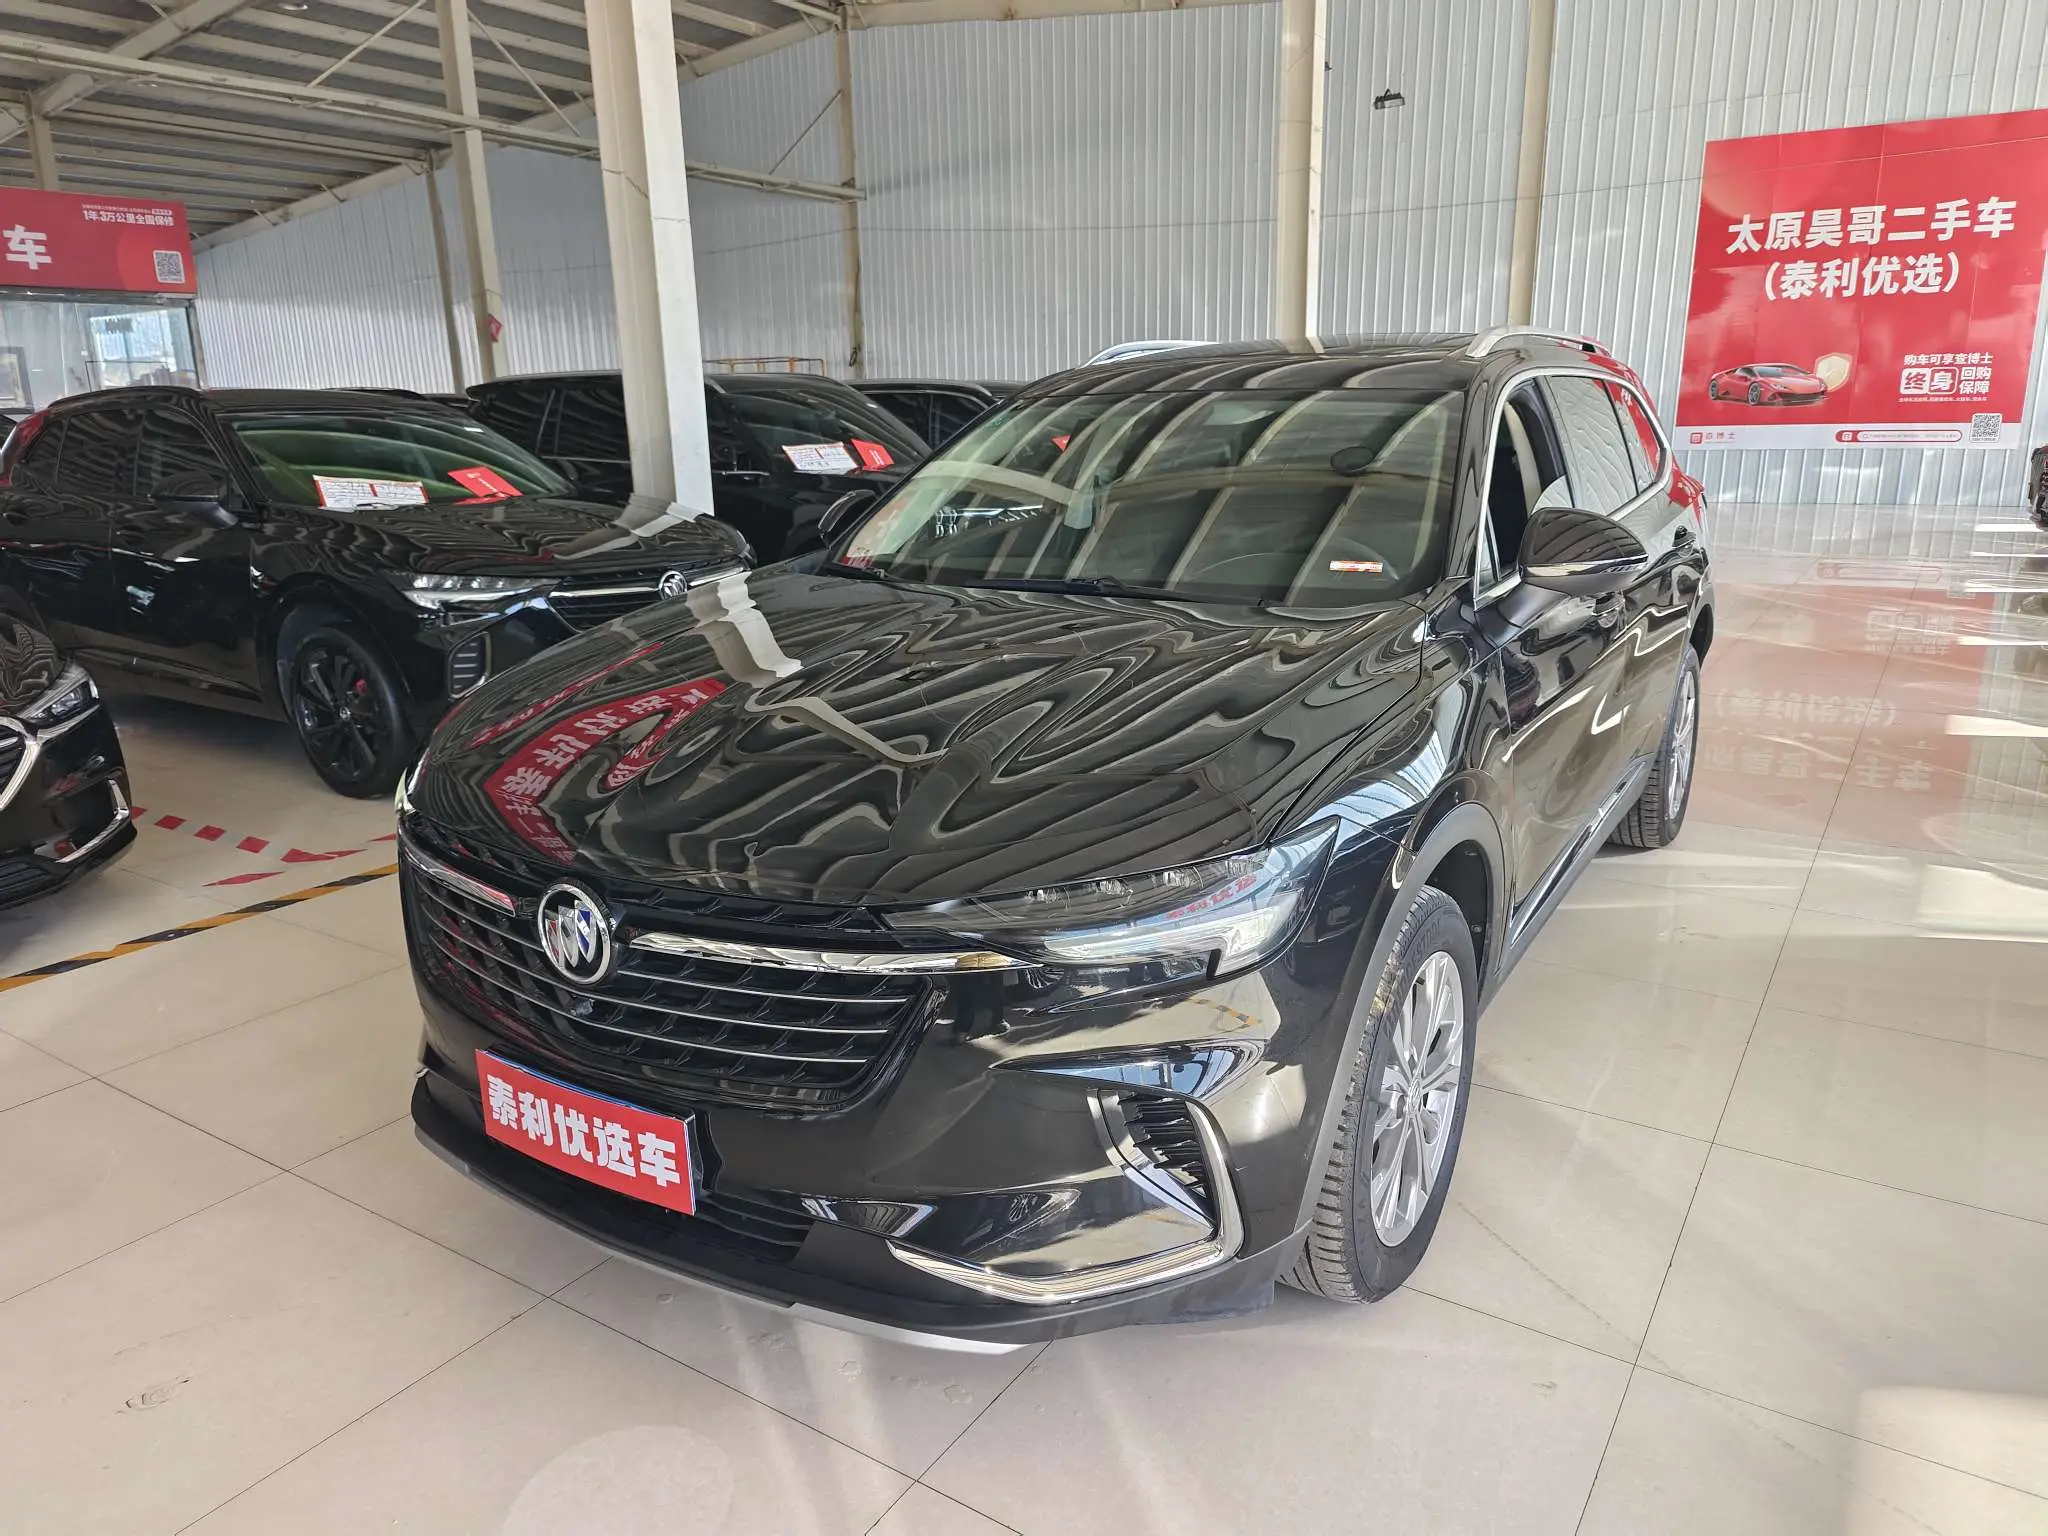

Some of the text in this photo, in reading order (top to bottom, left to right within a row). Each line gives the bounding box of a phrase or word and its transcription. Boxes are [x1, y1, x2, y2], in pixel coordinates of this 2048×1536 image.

[1726, 196, 2017, 255] 太原昊哥二手车
[3, 224, 53, 270] 车
[1764, 251, 1960, 301] (泰利优选)
[1903, 352, 1994, 365] 购车可享查博士
[1960, 366, 1992, 380] 回购
[1903, 370, 1955, 391] 终身
[1959, 381, 1991, 394] 保障
[486, 1074, 681, 1187] 泰利优选车
